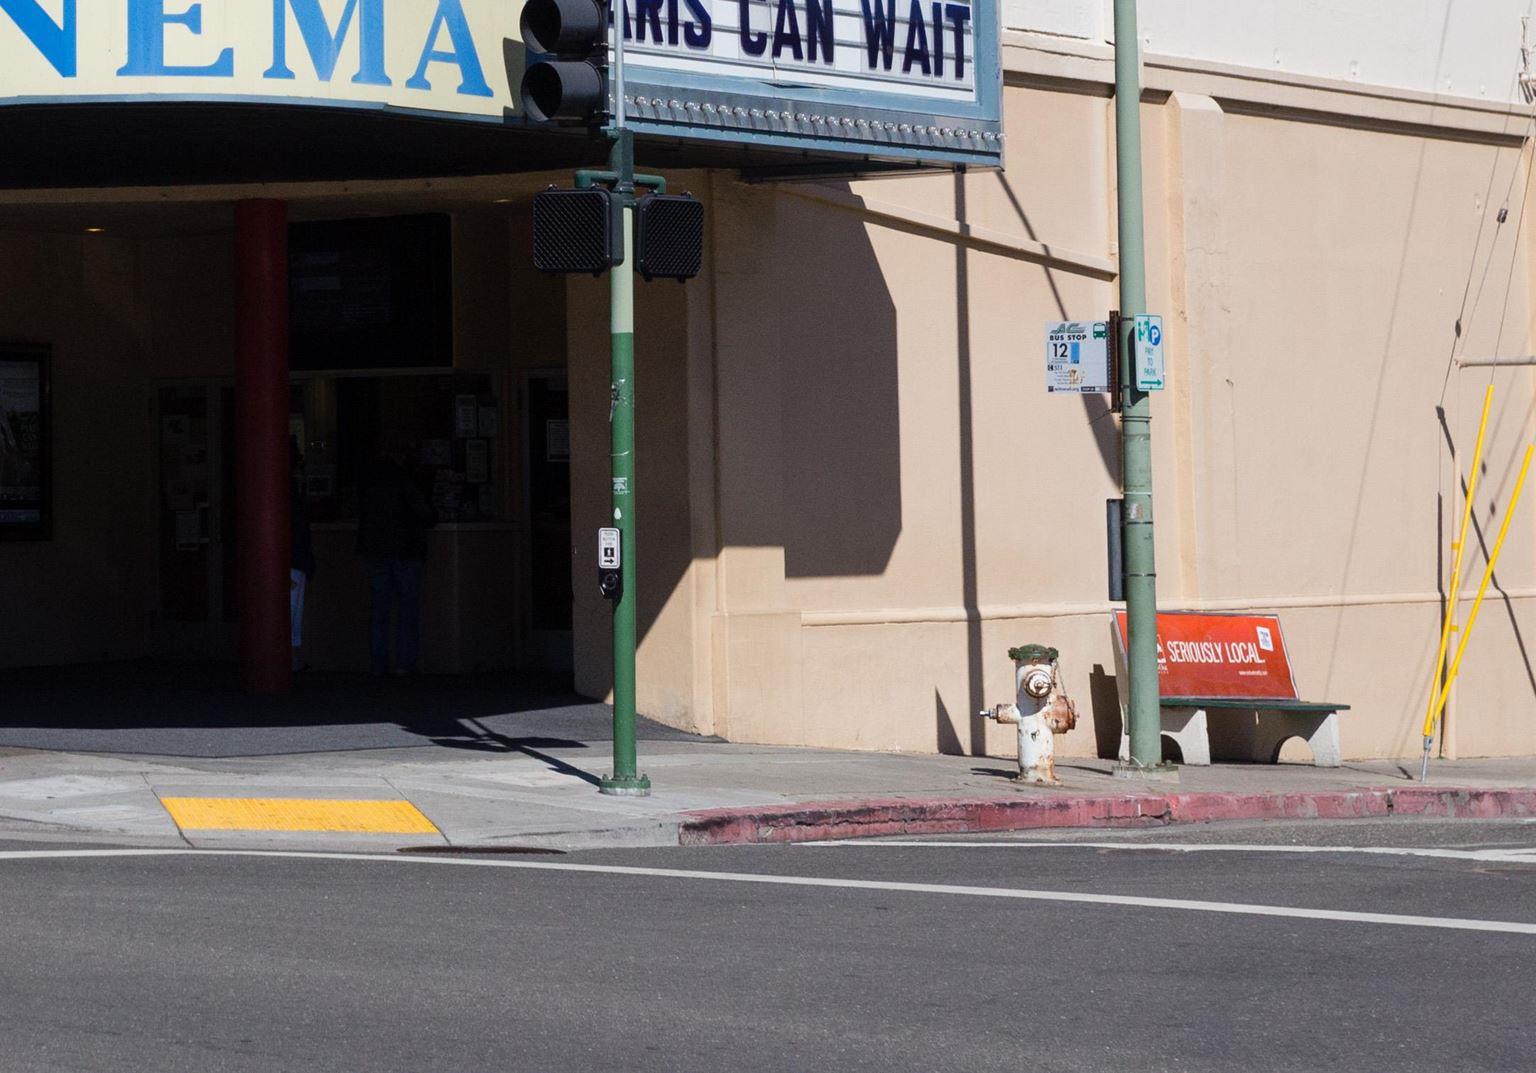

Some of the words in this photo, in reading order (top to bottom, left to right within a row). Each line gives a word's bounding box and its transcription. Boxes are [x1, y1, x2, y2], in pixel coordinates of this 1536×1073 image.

[1049, 334, 1065, 342] BUS
[1067, 334, 1087, 342] STOP
[1052, 343, 1069, 358] 12
[1166, 640, 1224, 664] SERIOUSLY
[1225, 641, 1266, 664] LOCAL.
